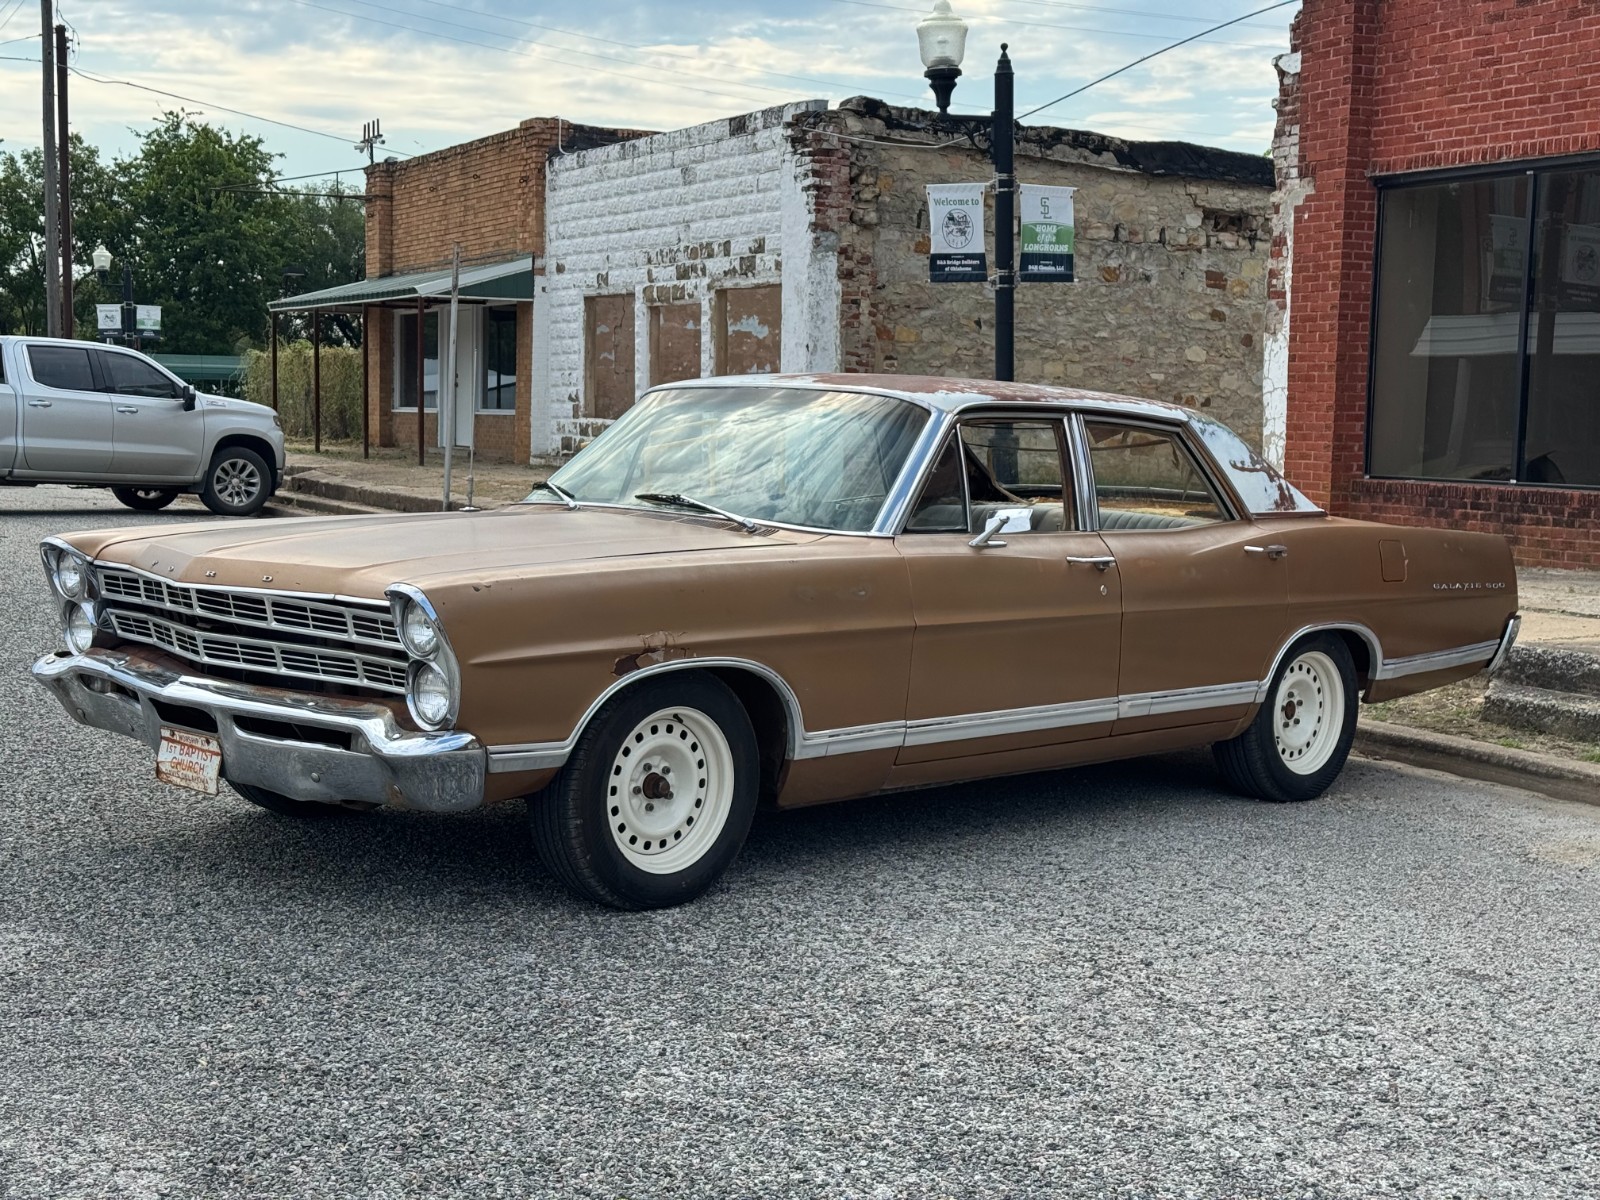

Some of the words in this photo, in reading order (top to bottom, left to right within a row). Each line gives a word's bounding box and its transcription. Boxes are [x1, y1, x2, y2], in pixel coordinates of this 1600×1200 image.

[933, 197, 970, 206] Welcome
[971, 198, 980, 206] to
[1036, 224, 1057, 233] HOME
[1037, 234, 1045, 244] of
[1045, 234, 1056, 243] the
[1024, 243, 1069, 252] LONGHORNS
[1433, 582, 1482, 591] GALAXIE
[179, 743, 213, 763] BAPTIST
[170, 756, 205, 777] CHURCH
